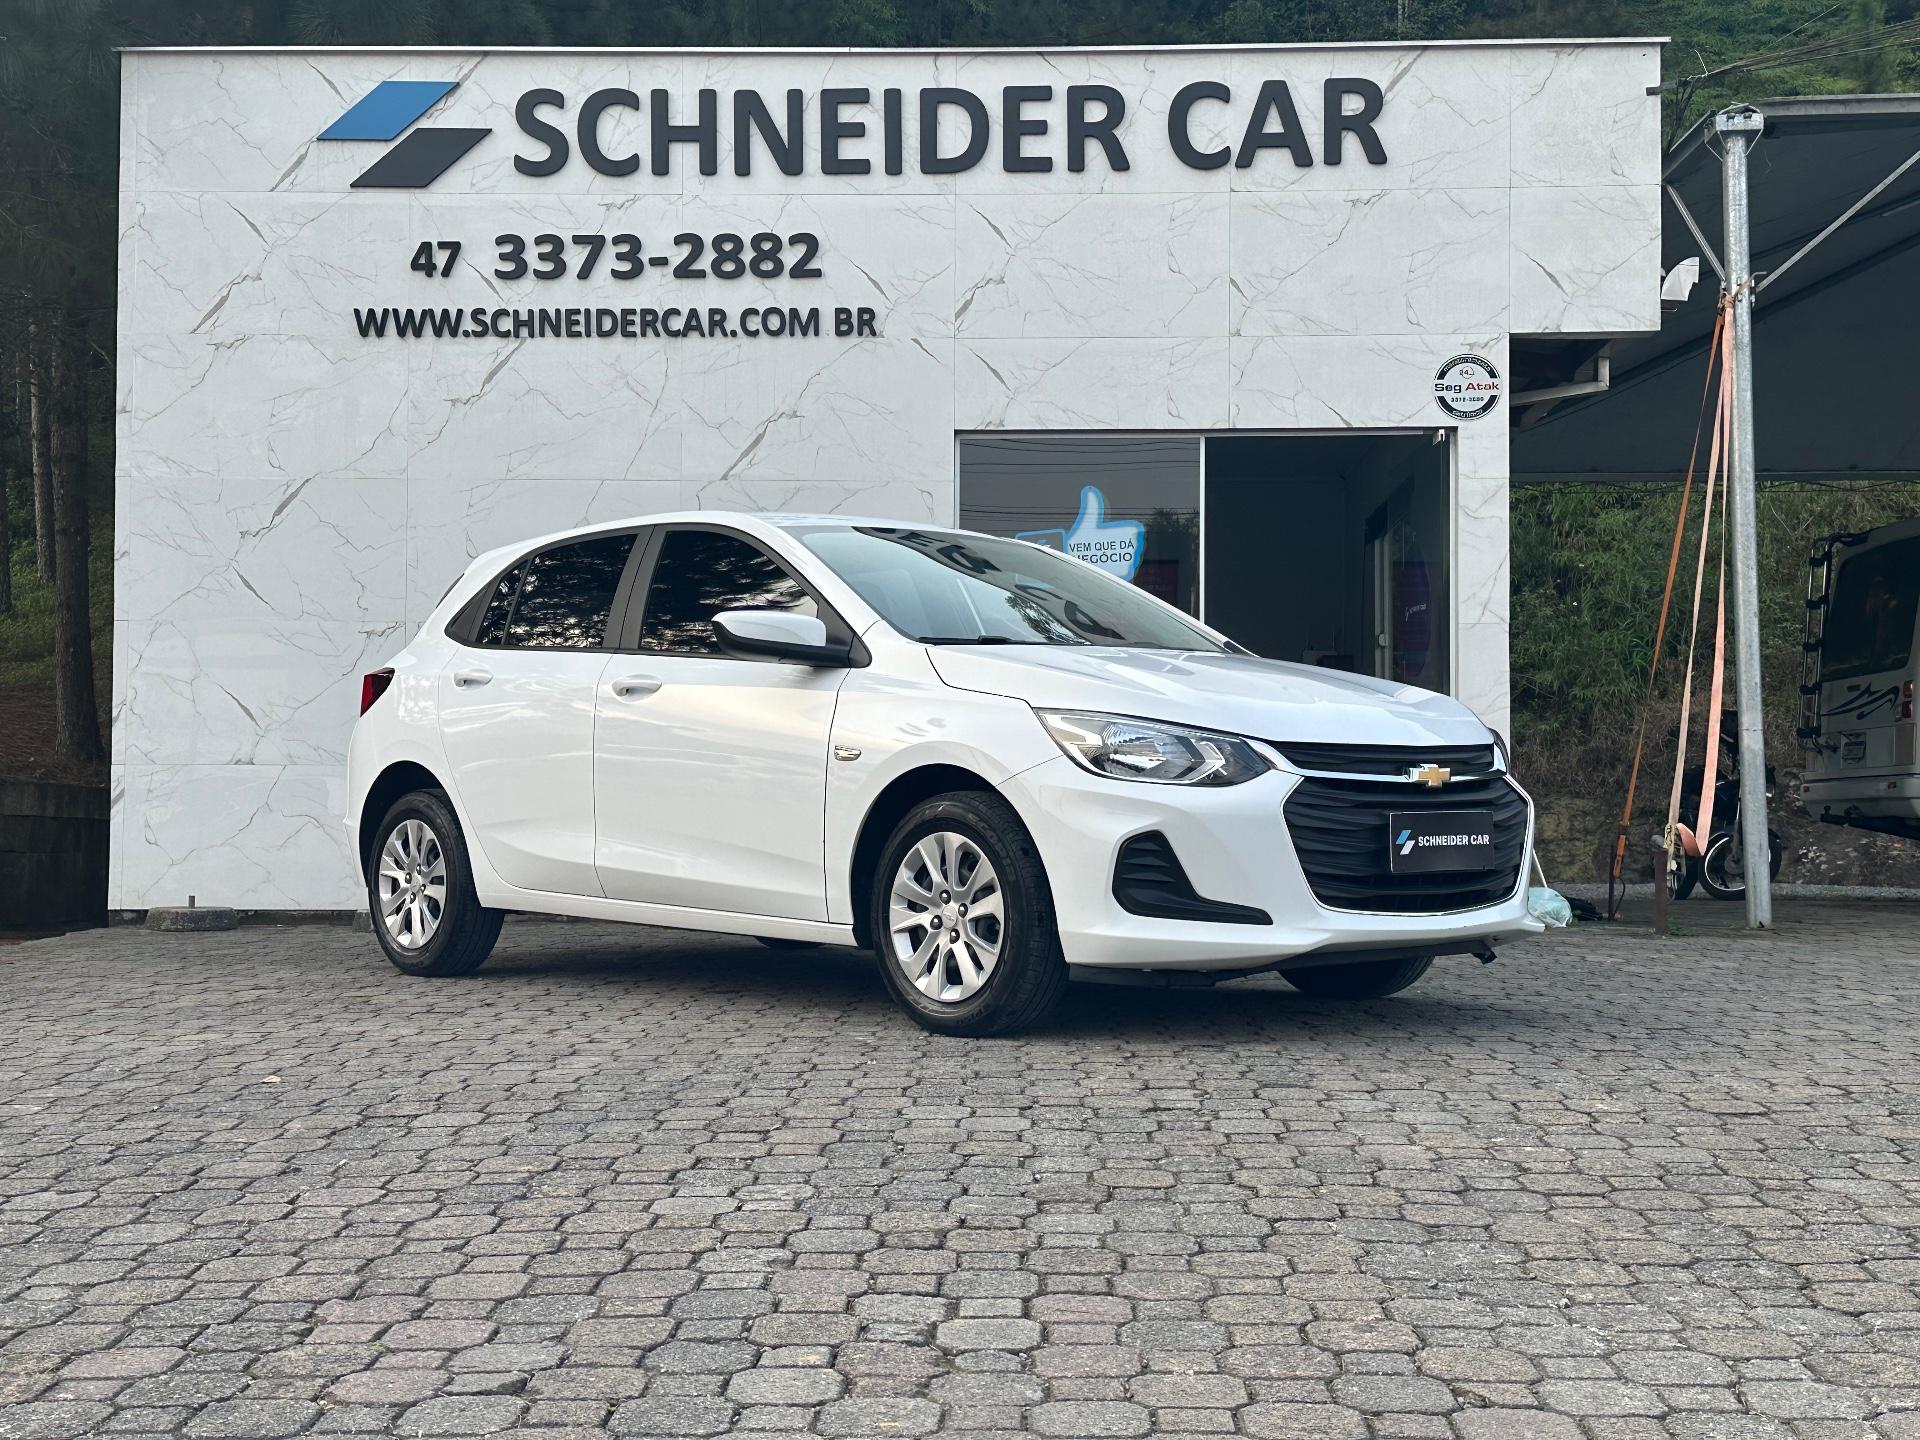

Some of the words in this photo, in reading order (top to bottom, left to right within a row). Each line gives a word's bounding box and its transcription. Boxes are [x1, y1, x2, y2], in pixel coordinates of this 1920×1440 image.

[514, 85, 1130, 177] SCHNEIDER
[1168, 78, 1387, 171] CAR
[411, 240, 462, 278] 47
[494, 232, 823, 280] 3373-2882
[353, 306, 820, 339] WWW.SCHNEIDERCAR.COM
[834, 306, 878, 338] BR
[1435, 383, 1462, 393] Seg
[1465, 382, 1499, 391] Atak
[1069, 542, 1092, 553] VEM
[1094, 541, 1117, 552] QUE
[1119, 538, 1135, 550] DÁ
[1077, 552, 1133, 563] EGÓCIO
[1418, 835, 1469, 847] SCHNEIDER
[1471, 834, 1490, 845] CAR
